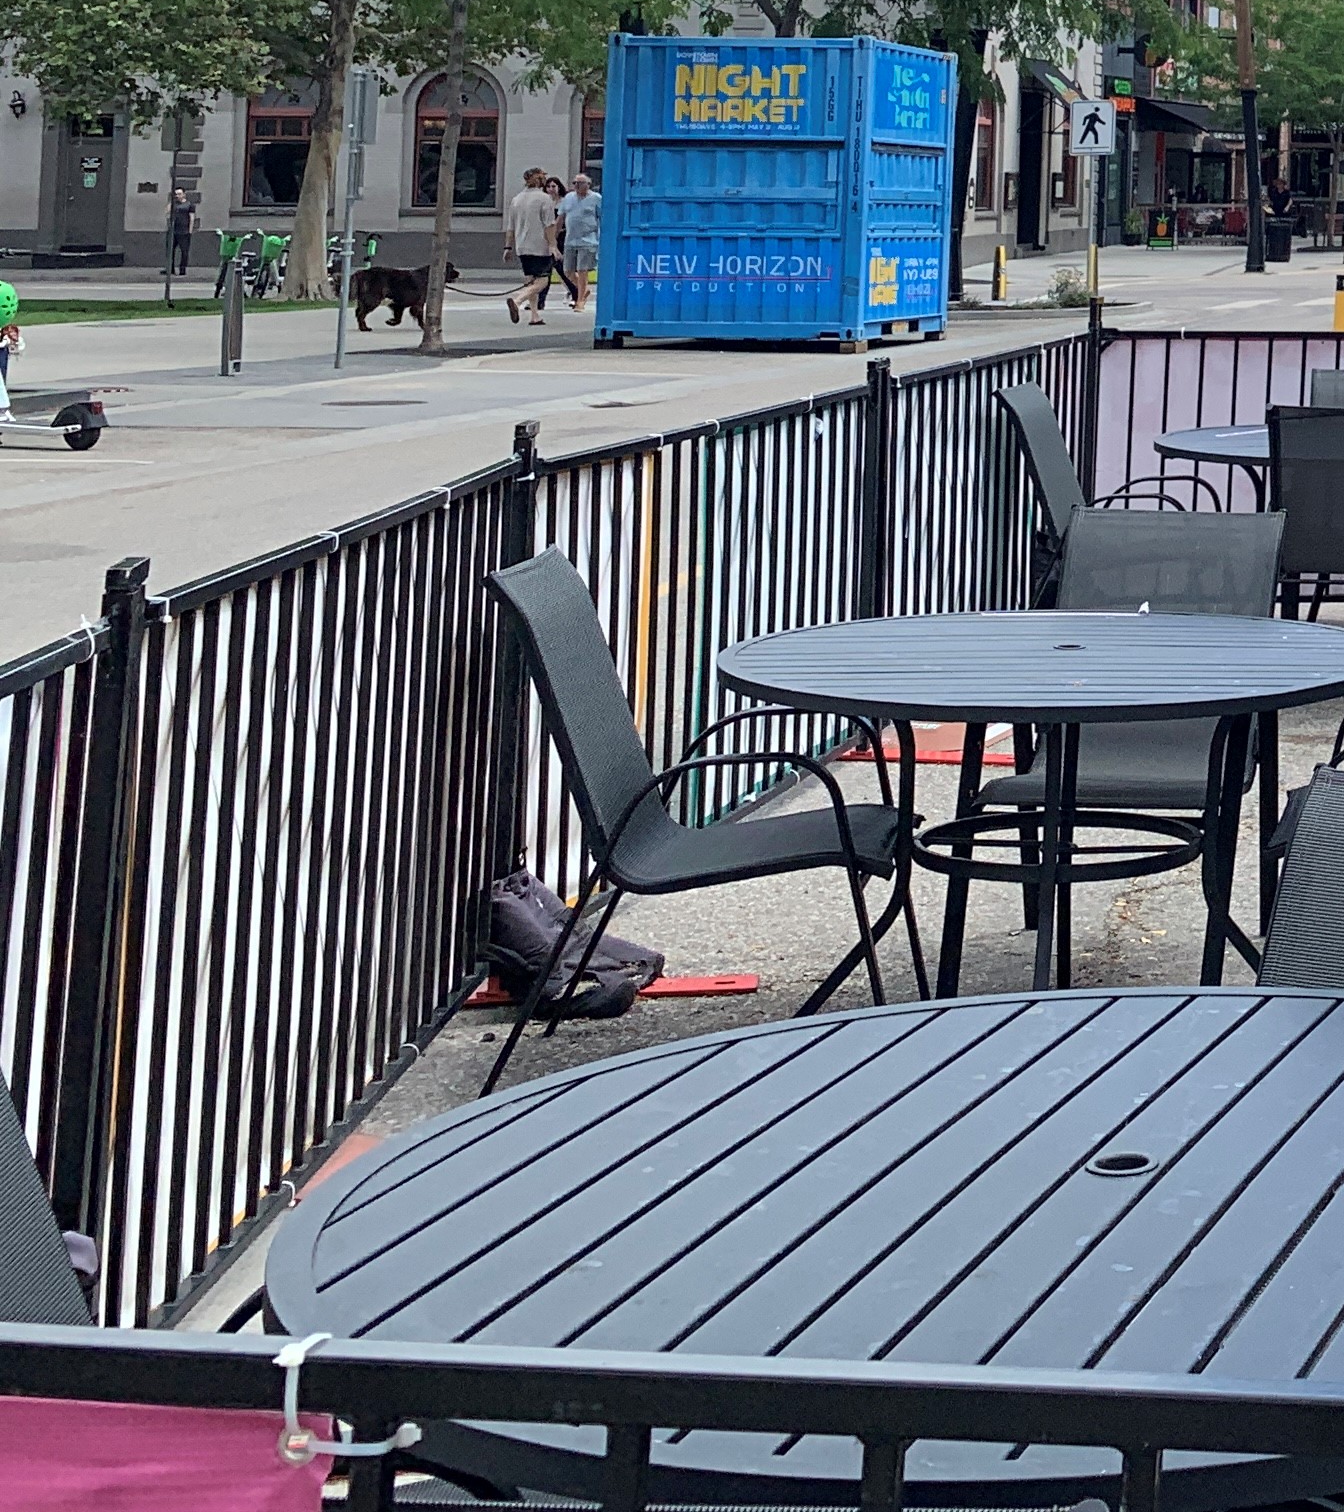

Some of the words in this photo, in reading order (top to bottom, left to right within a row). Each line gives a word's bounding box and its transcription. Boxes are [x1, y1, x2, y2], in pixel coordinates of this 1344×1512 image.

[675, 64, 807, 96] NIGHT
[674, 97, 804, 122] MARKET
[637, 254, 697, 275] NEW
[709, 255, 822, 276] HORIZON
